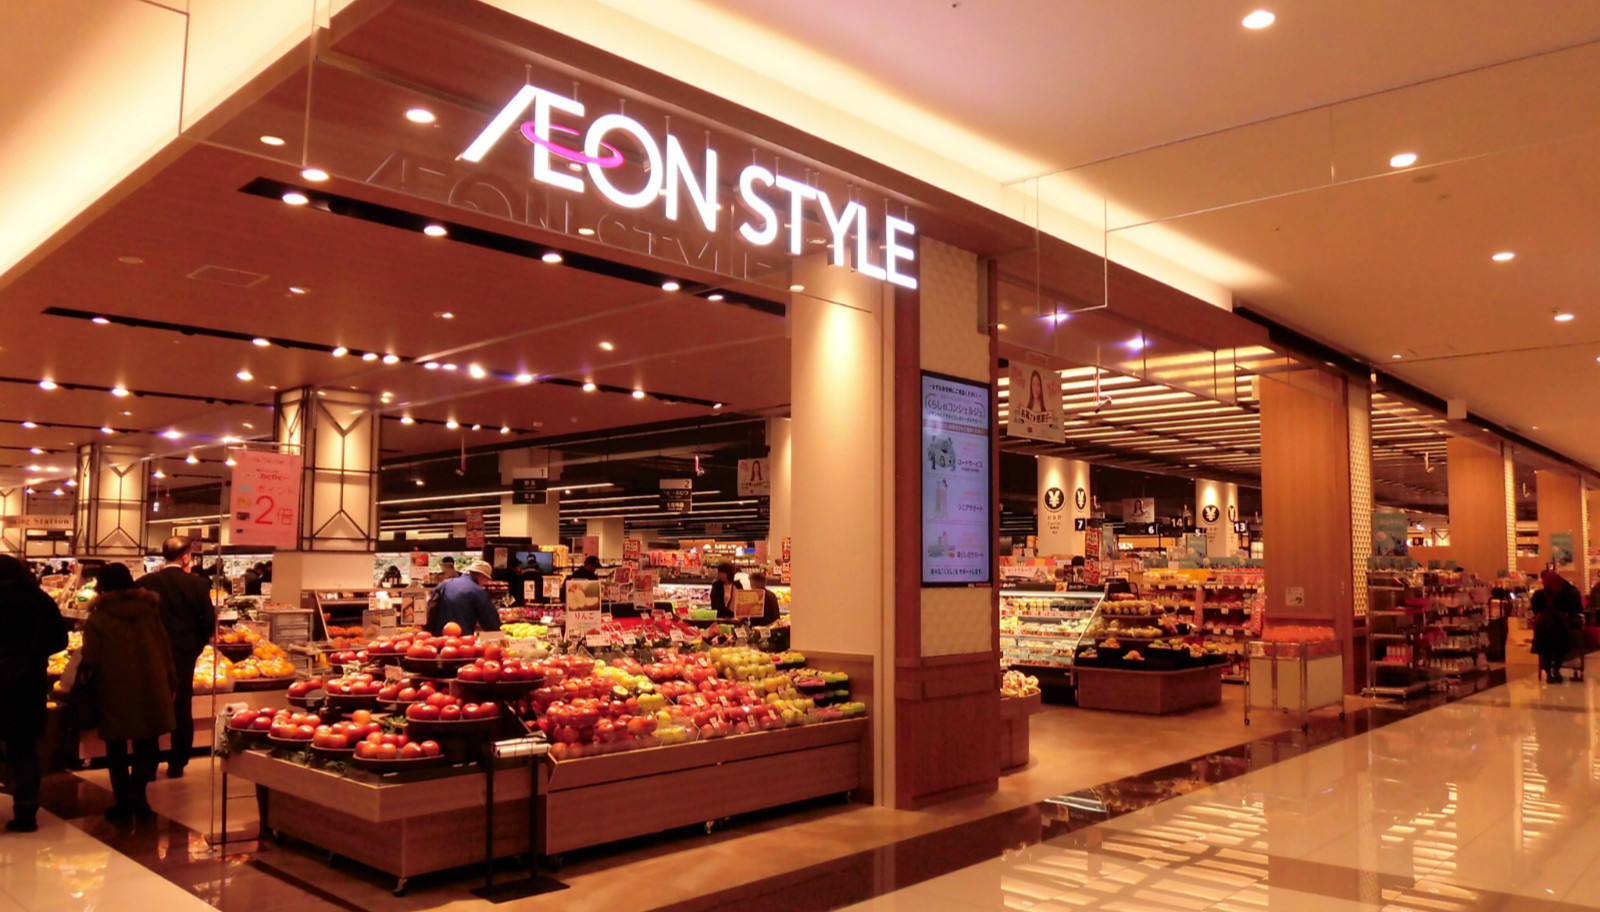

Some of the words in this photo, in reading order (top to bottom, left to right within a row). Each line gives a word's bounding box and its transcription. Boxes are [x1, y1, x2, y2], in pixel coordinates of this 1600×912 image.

[739, 165, 917, 289] STYLE
[540, 468, 544, 477] 1
[684, 480, 690, 488] 2
[256, 485, 295, 497] ポイント
[34, 517, 69, 525] Station
[1077, 520, 1084, 529] 7
[1171, 517, 1183, 528] 14
[1148, 525, 1155, 535] 6
[1234, 522, 1246, 532] 13
[574, 611, 595, 621] りんご
